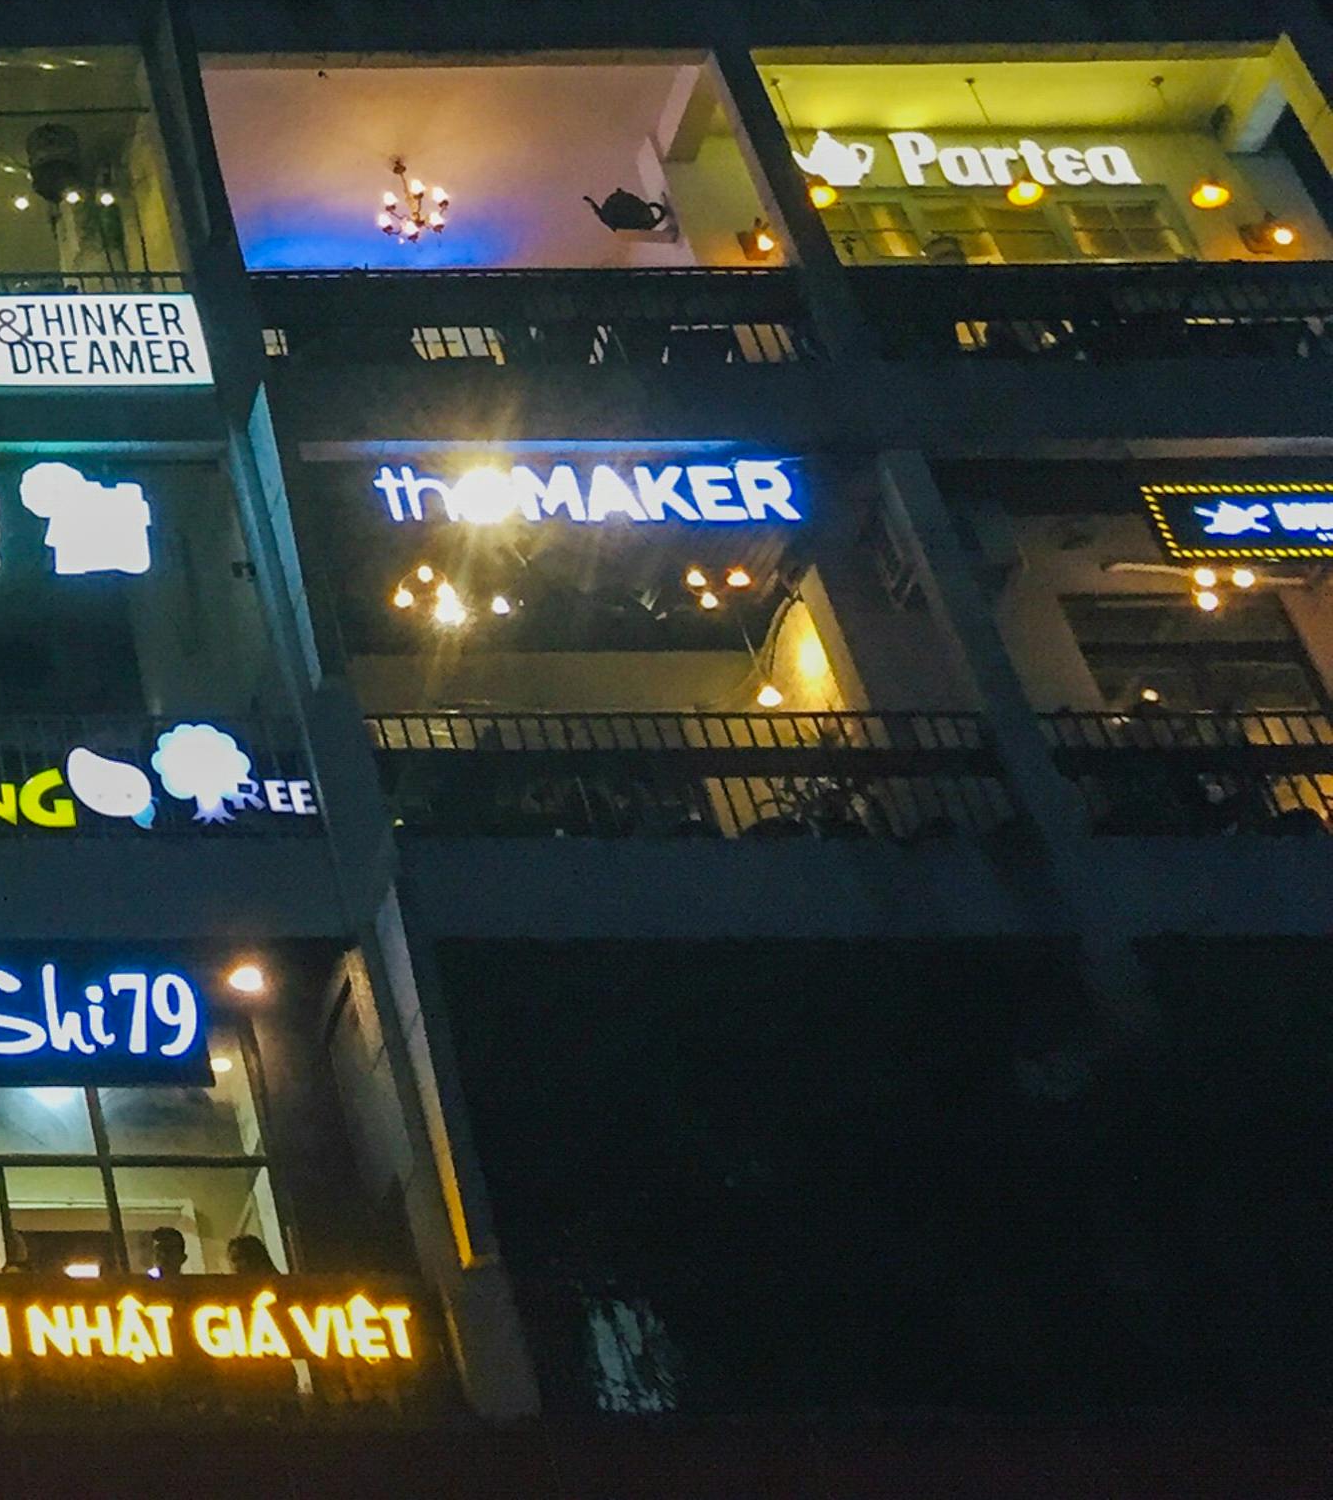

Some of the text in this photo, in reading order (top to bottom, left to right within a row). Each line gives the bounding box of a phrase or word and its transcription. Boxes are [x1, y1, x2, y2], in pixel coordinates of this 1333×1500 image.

[889, 130, 1142, 187] Partea
[16, 302, 184, 337] THINKER
[8, 339, 197, 375] DREAMER
[510, 458, 803, 523] MAKER
[27, 1293, 175, 1364] NHẬT
[192, 1290, 293, 1360] GIÁ
[288, 1291, 414, 1364] VIỆT
